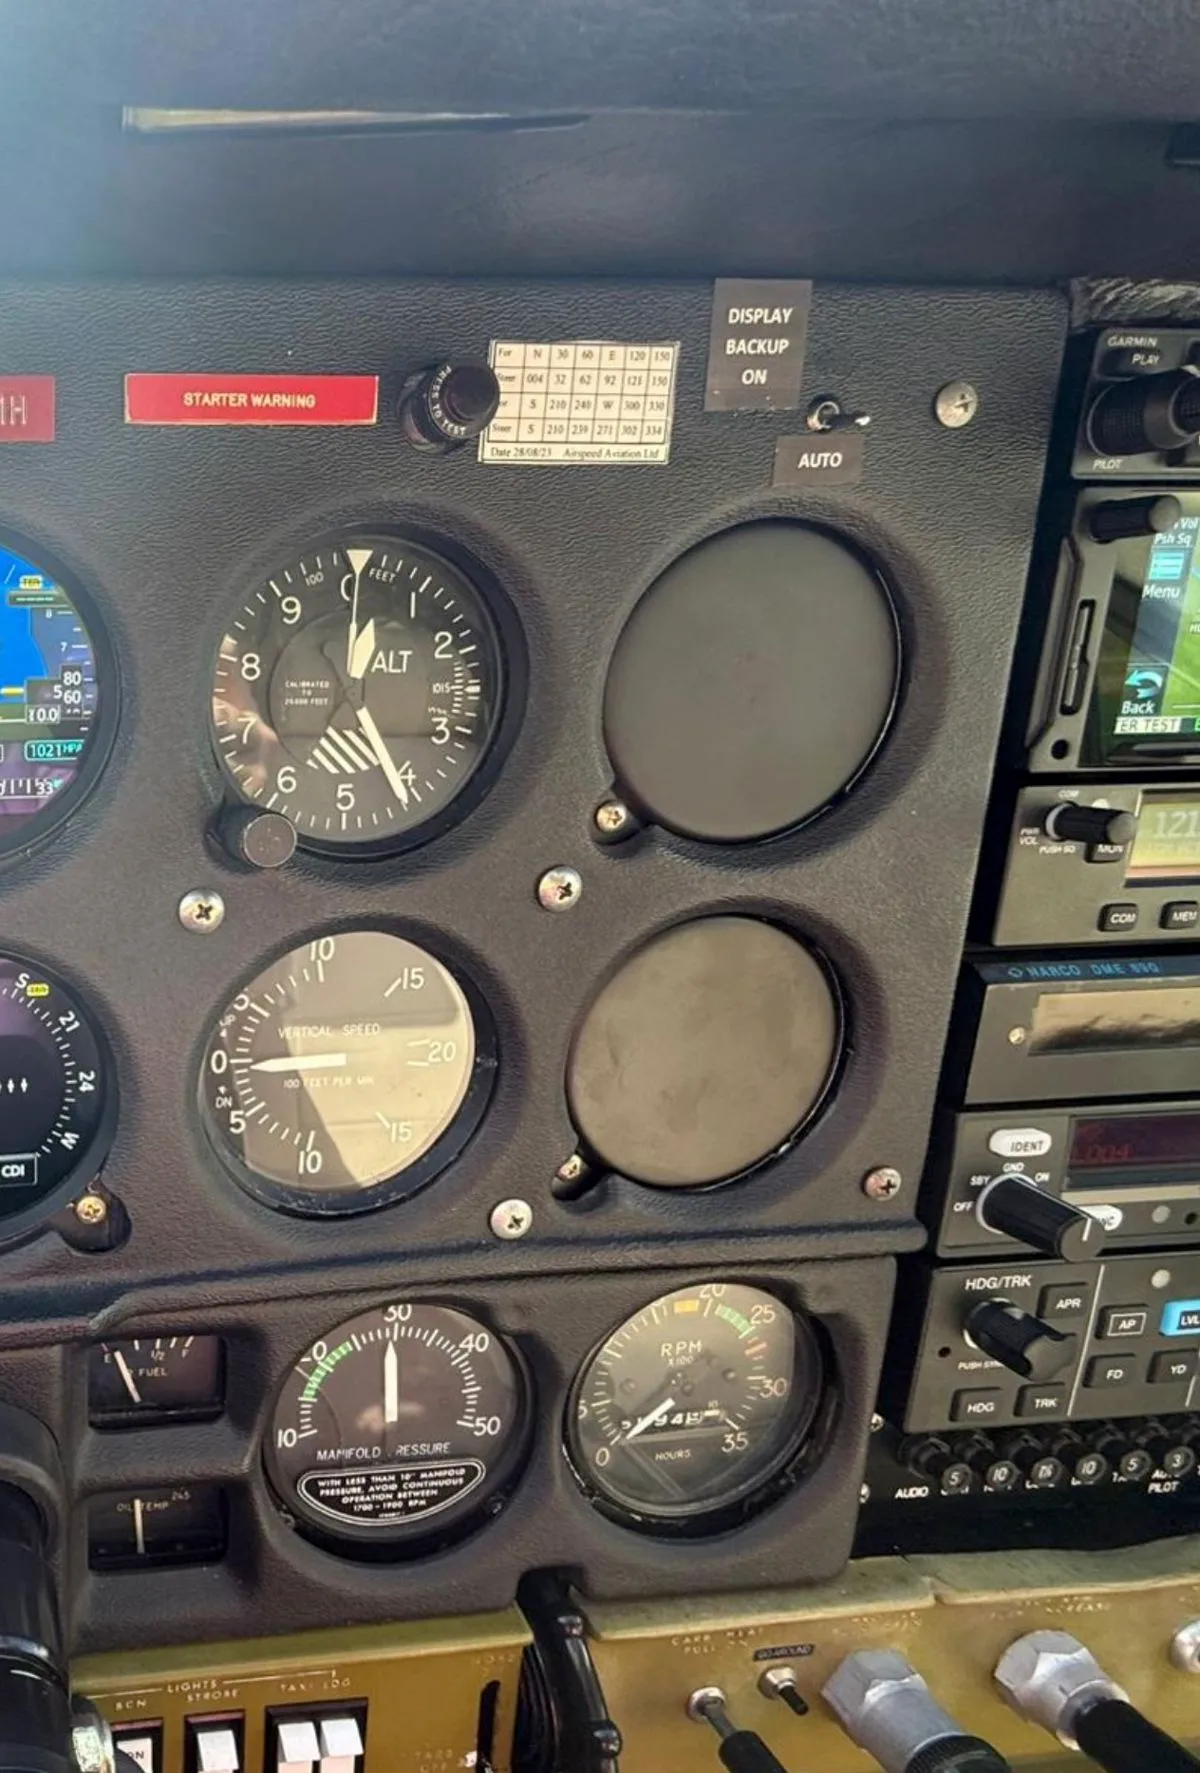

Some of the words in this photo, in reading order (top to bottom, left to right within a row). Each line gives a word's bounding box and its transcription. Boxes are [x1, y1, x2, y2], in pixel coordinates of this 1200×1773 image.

[728, 307, 793, 325] DISPLAY
[725, 339, 789, 355] BACKUP
[1107, 336, 1158, 347] GARMIN
[557, 350, 569, 359] 30
[582, 351, 594, 359] 60
[609, 351, 615, 360] E
[630, 351, 645, 360] 120
[654, 352, 670, 361] 150
[1132, 354, 1159, 365] PLAY
[741, 369, 767, 385] ON
[183, 392, 249, 407] STARTER
[251, 393, 316, 408] WARNING
[564, 449, 601, 459] Airspeed
[605, 449, 641, 458] Aviation
[644, 449, 660, 458] Ltd
[798, 451, 842, 469] AUTO
[1092, 459, 1124, 469] PILOT
[1154, 534, 1175, 544] Psh
[368, 567, 396, 583] FEET
[1142, 585, 1180, 599] Menu
[281, 597, 301, 624] 9
[434, 631, 453, 658] 2
[241, 653, 260, 680] 8
[371, 651, 413, 673] ALT
[1122, 701, 1155, 714] Back
[237, 716, 257, 743] 7
[431, 717, 450, 745] 3
[1143, 718, 1178, 730] TEST
[277, 766, 296, 793] 6
[336, 783, 355, 811] 5
[1110, 913, 1136, 924] COM
[1172, 911, 1198, 921] MEM
[310, 938, 335, 960] 10
[15, 973, 29, 988] S
[402, 968, 424, 989] 15
[59, 1012, 80, 1032] 21
[278, 1026, 332, 1038] VERTICAL
[343, 1024, 380, 1036] SPEED
[428, 1043, 456, 1062] 20
[211, 1051, 227, 1073] 0
[79, 1071, 96, 1092] 24
[216, 1096, 233, 1108] DN
[230, 1111, 245, 1133] 5
[391, 1122, 413, 1142] 15
[1010, 1141, 1044, 1153] IDENT
[298, 1151, 322, 1173] 10
[1003, 1163, 1024, 1172] GND
[1, 1165, 25, 1177] CDI
[1035, 1173, 1050, 1182] ON
[971, 1176, 990, 1186] SBY
[953, 1203, 973, 1212] OFF
[965, 1274, 1033, 1291] HDG/TRK
[1055, 1298, 1082, 1309] APR
[751, 1305, 776, 1324] 25
[1119, 1319, 1136, 1330] AP
[459, 1333, 490, 1352] 40
[661, 1341, 702, 1357] RPM
[139, 1368, 168, 1377] FUEL
[1106, 1368, 1123, 1380] FD
[1171, 1364, 1186, 1374] YD
[760, 1378, 788, 1397] 30
[967, 1401, 994, 1413] HDG
[1034, 1398, 1057, 1409] TRK
[474, 1416, 500, 1435] 50
[277, 1429, 296, 1447] 10
[722, 1432, 749, 1453] 35
[596, 1449, 610, 1466] 0
[655, 1449, 691, 1461] HOURS
[346, 1477, 366, 1485] LESS
[371, 1475, 395, 1483] THAN
[420, 1468, 465, 1479] MANIFOLD
[369, 1484, 397, 1492] AVOID
[403, 1478, 464, 1489] CONTINUOUS
[895, 1486, 929, 1499] AUDIO
[1148, 1482, 1179, 1493] PILOT
[342, 1494, 393, 1504] OPERATION
[397, 1489, 438, 1499] BETWEEN
[167, 1679, 218, 1694] LIGHTS
[115, 1698, 148, 1711] BCN
[187, 1689, 241, 1703] STROBE
